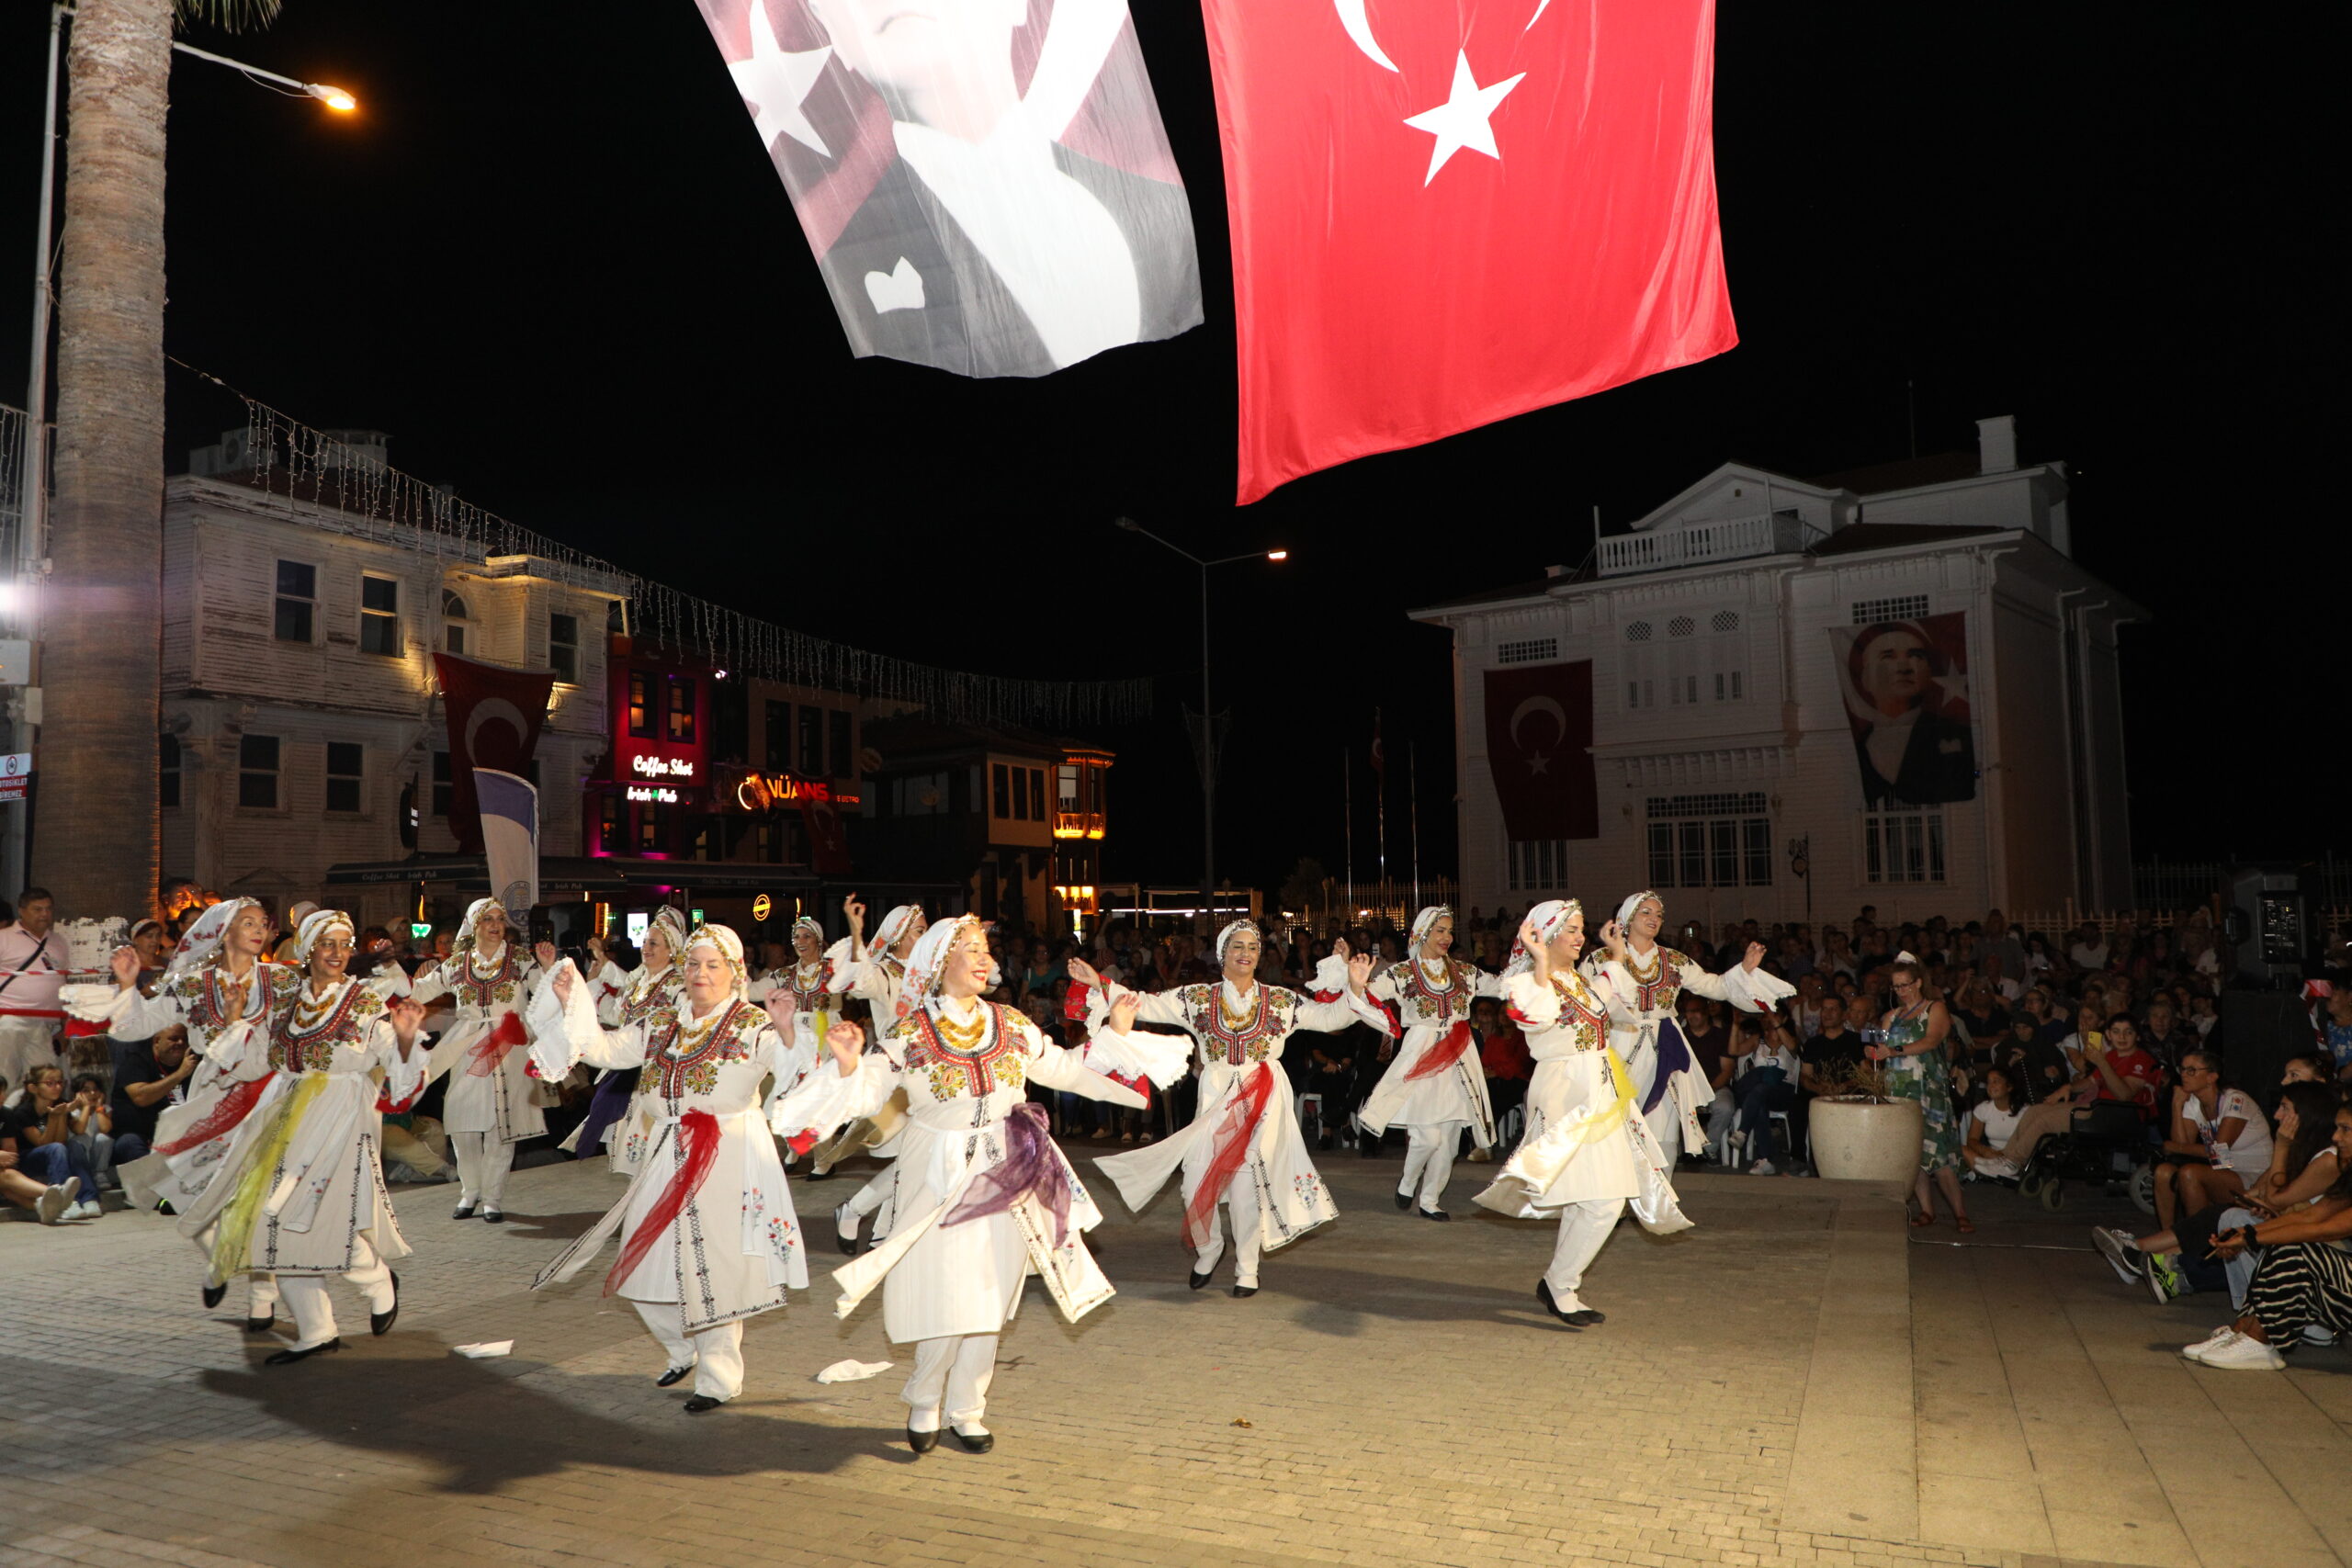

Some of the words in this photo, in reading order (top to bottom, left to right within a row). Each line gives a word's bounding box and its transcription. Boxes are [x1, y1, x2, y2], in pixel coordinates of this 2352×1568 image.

[633, 754, 669, 778] Coffee
[670, 758, 694, 776] Shot
[627, 785, 652, 802] Irish
[658, 788, 678, 803] Pub
